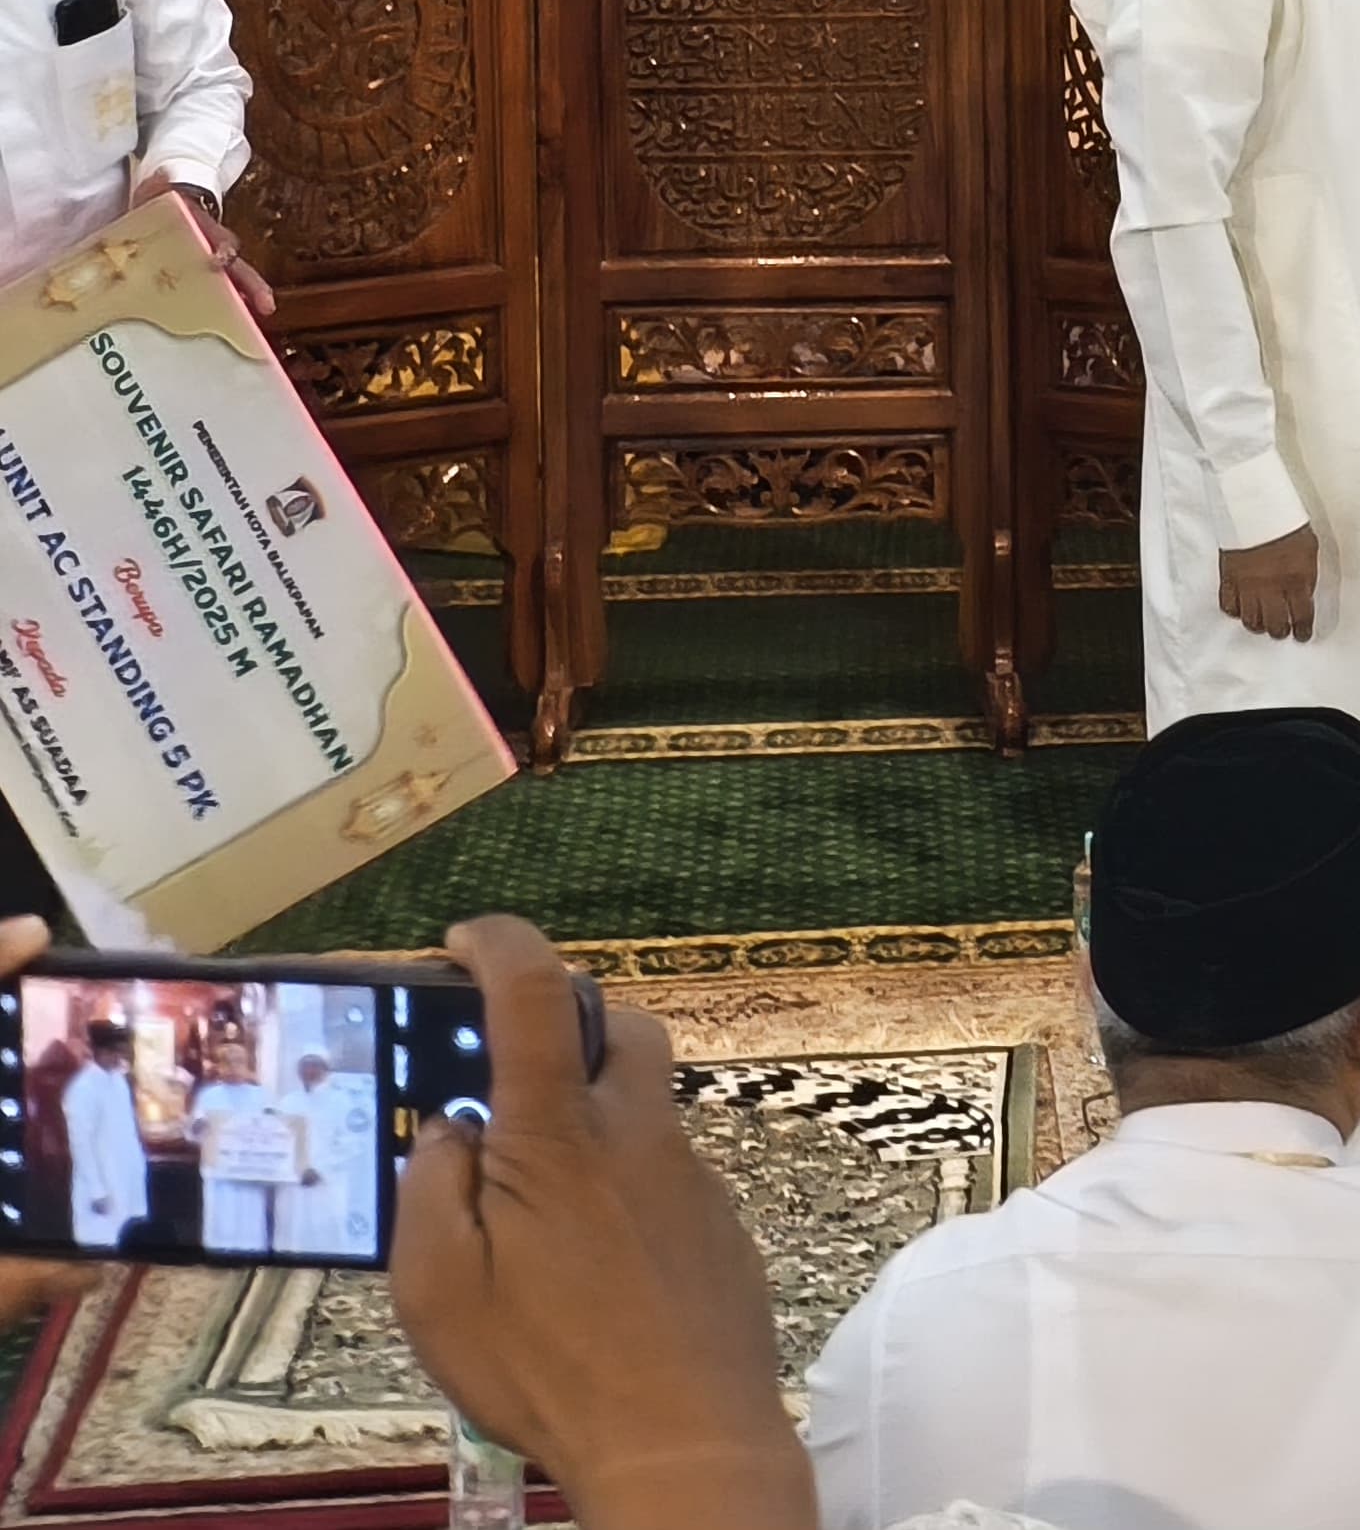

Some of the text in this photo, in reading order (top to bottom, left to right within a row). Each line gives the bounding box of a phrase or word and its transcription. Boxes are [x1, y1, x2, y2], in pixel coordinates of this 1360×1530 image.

[0, 443, 219, 818] UNIT AC STANDING 5 PK
[90, 333, 353, 772] SOUVENIR SAFARI RAMADHAN
[114, 558, 163, 637] Berupa
[122, 466, 258, 677] 1446H/2025 M
[193, 420, 324, 639] PEMERINTAH KOTA BALIKPAPAN
[12, 687, 39, 714] AS
